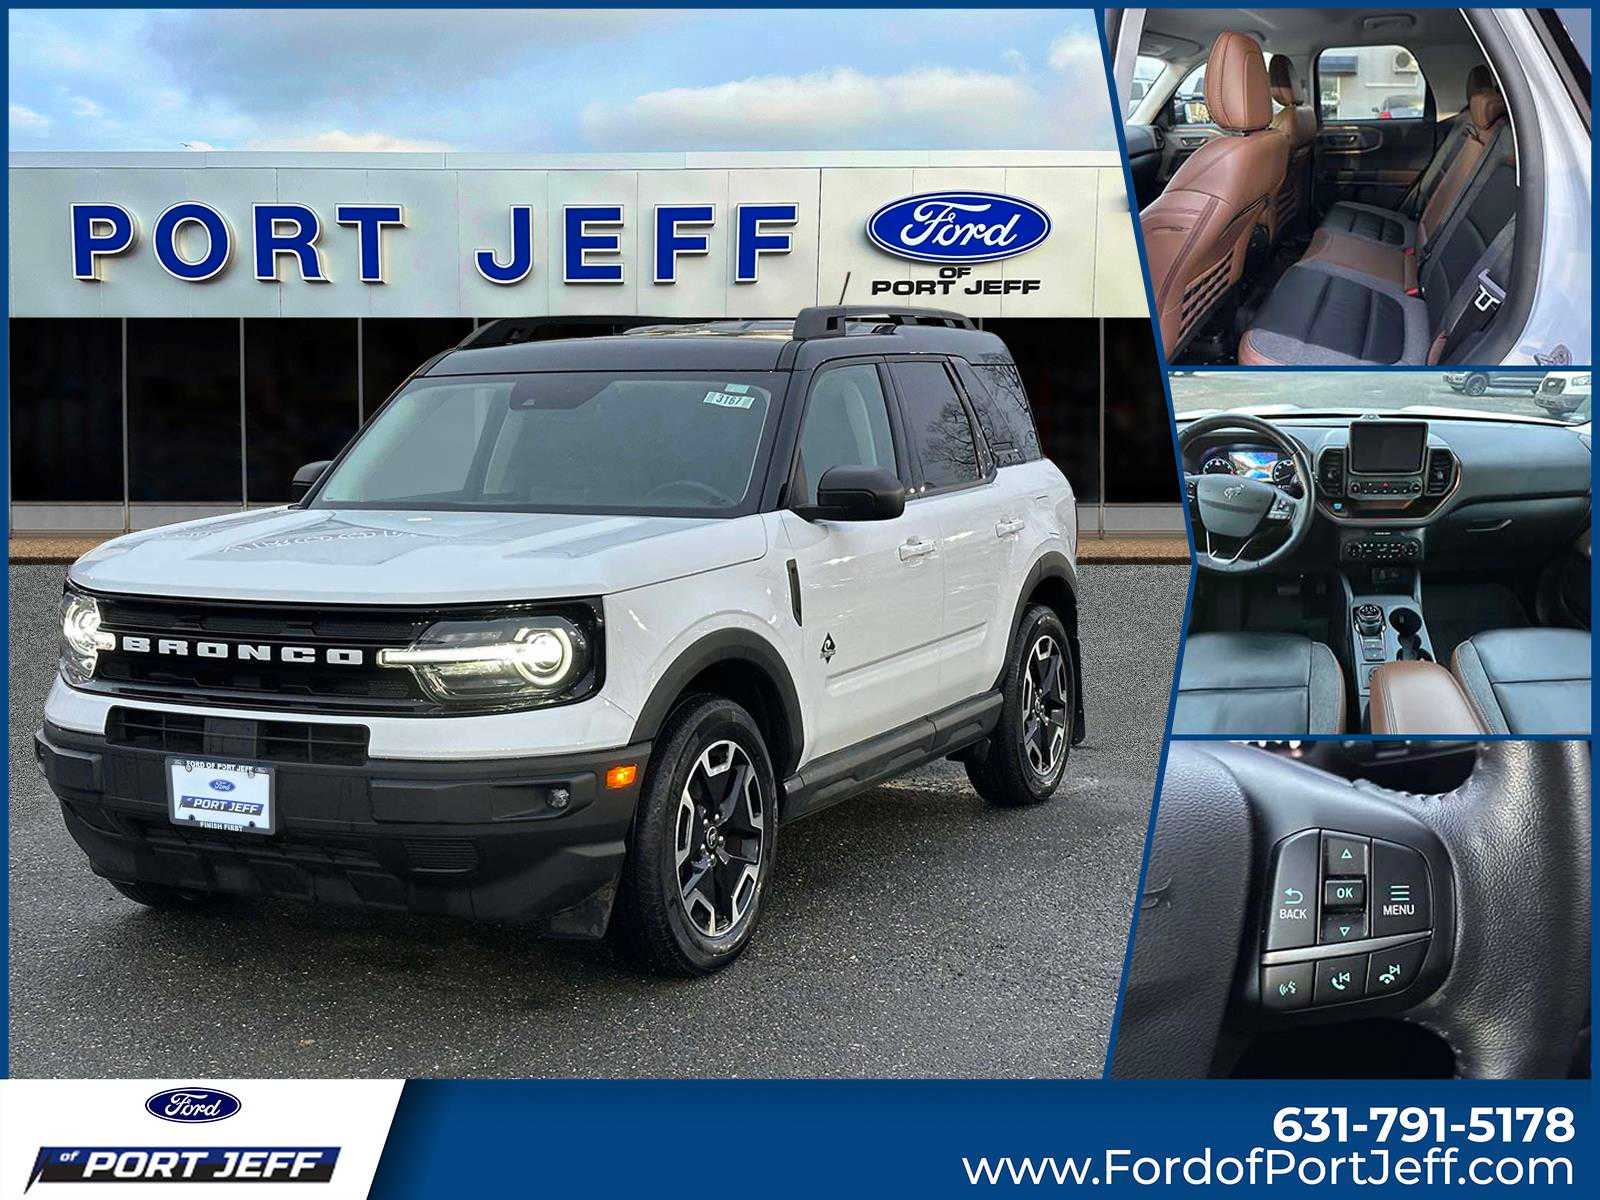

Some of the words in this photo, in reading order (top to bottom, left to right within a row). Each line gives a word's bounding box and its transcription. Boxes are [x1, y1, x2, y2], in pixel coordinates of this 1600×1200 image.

[900, 201, 1021, 247] Ford
[70, 202, 404, 283] PORT
[473, 202, 799, 285] JEFF
[939, 266, 972, 279] OF
[871, 280, 956, 295] PORT
[964, 280, 1041, 295] JEFF
[122, 636, 363, 665] BRONCO
[218, 763, 236, 772] PORT
[214, 780, 231, 792] Ford
[193, 798, 228, 811] PORT
[228, 802, 260, 814] JEFF
[1336, 887, 1353, 899] OK
[1279, 908, 1307, 920] BACK
[1383, 904, 1415, 915] MENU
